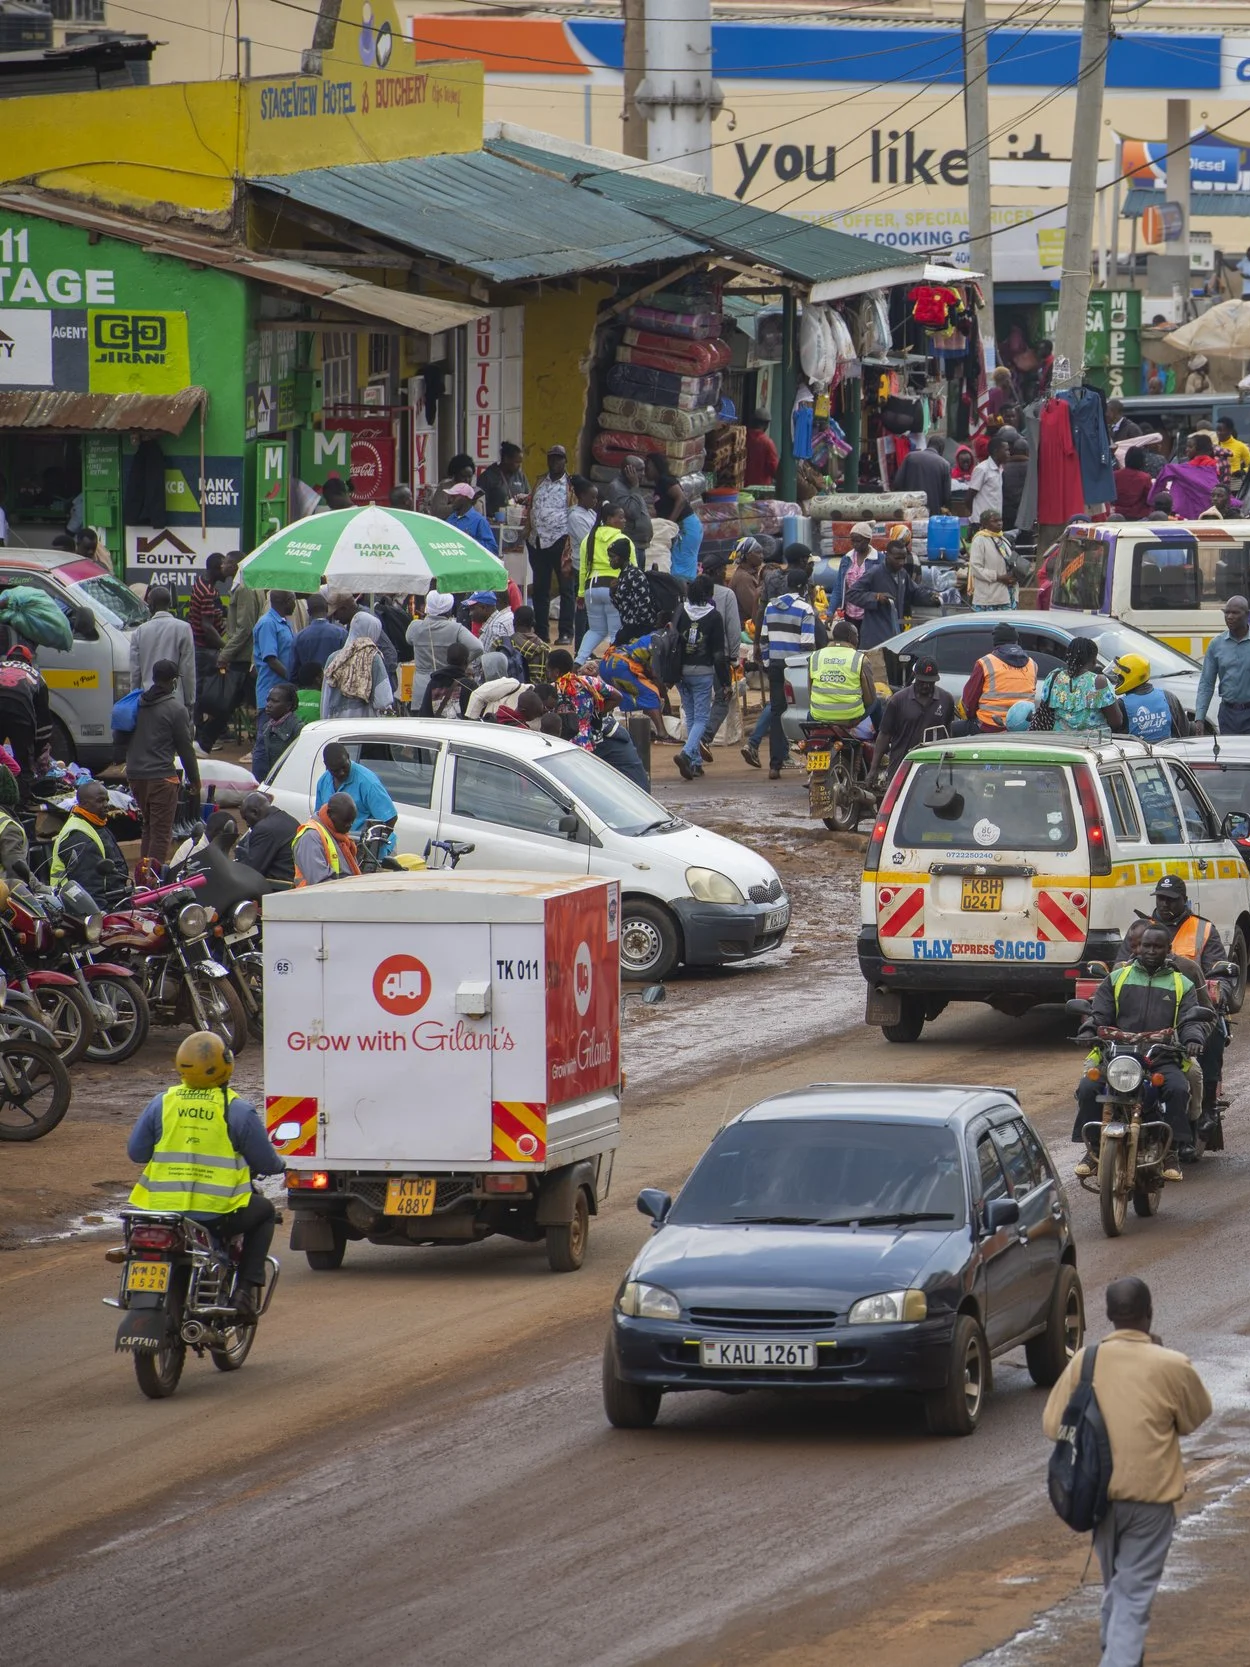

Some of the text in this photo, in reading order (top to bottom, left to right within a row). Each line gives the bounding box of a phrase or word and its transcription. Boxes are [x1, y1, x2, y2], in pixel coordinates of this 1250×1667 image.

[261, 82, 318, 120] STAGEVIEW
[322, 80, 356, 115] HOTEL
[376, 75, 428, 109] BUTCHERY
[734, 143, 837, 200] you
[871, 129, 969, 186] like
[842, 213, 900, 229] OFFER,
[904, 210, 969, 227] SPECIAL
[989, 208, 1035, 225] RICES
[874, 231, 954, 247] COOKING
[52, 326, 87, 339] AGENT
[95, 351, 166, 365] JIRANI
[313, 431, 347, 466] M
[264, 446, 283, 480] M
[165, 480, 185, 494] KCB
[286, 540, 322, 551] BAMBA
[354, 543, 400, 551] BAMBA
[429, 542, 466, 550] BAMBA
[136, 554, 197, 565] EQUITY
[285, 548, 313, 558] HAPA
[359, 550, 395, 558] HAPA
[438, 549, 467, 557] HAPA
[1132, 711, 1167, 723] DOUBLE
[1149, 718, 1168, 728] Life
[971, 879, 998, 894] KBH
[912, 939, 1046, 960] FLAX EXPRESS SACCO
[276, 962, 290, 973] 65
[496, 959, 540, 980] TK 011
[287, 1019, 519, 1052] Grow with Gilani's
[551, 1063, 567, 1080] Grow
[177, 1107, 215, 1121] watu
[397, 1198, 429, 1214] 488Y
[120, 1336, 160, 1348] CAPTAIN
[720, 1344, 809, 1365] KAU 126T
